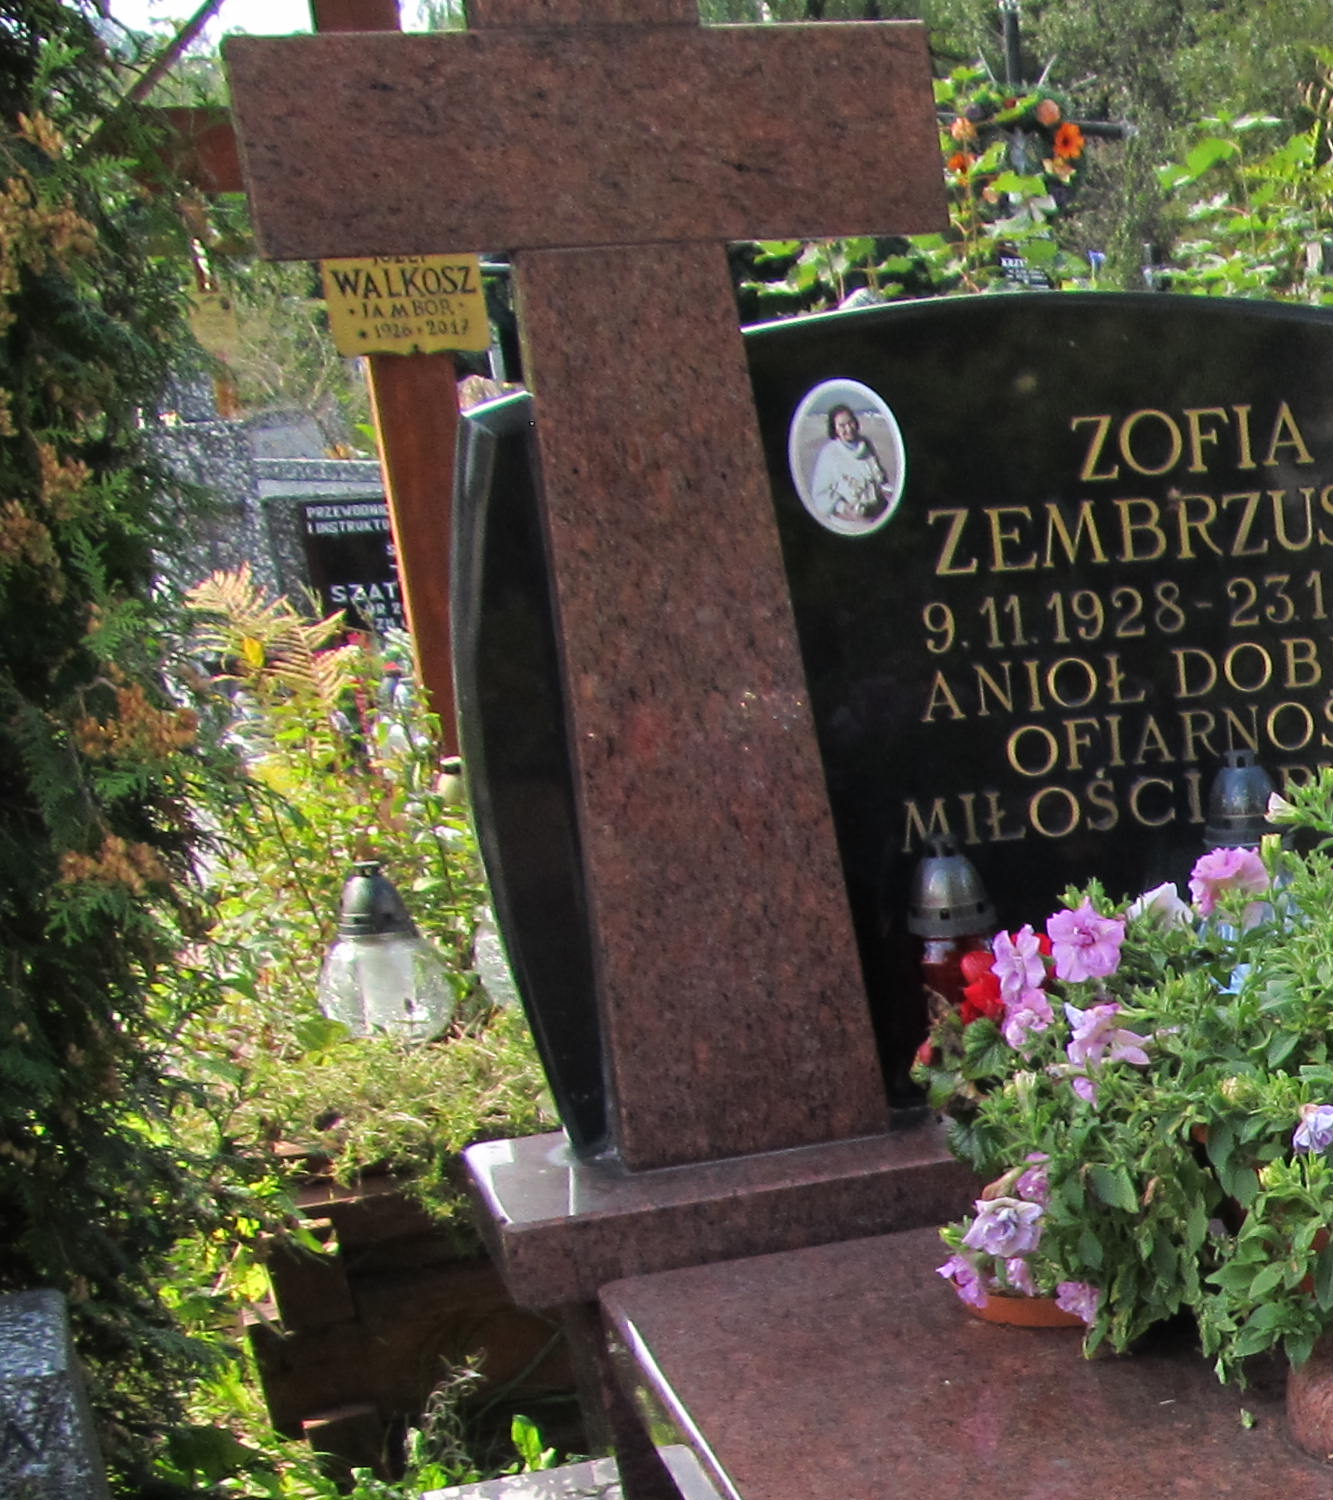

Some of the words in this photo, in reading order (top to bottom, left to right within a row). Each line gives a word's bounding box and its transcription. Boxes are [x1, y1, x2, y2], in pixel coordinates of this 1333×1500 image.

[330, 266, 476, 299] WALKOSZ
[1070, 400, 1315, 483] ZOFIA
[922, 653, 1147, 723] ANIOŁ
[901, 768, 1206, 852] MIŁOŚCI
